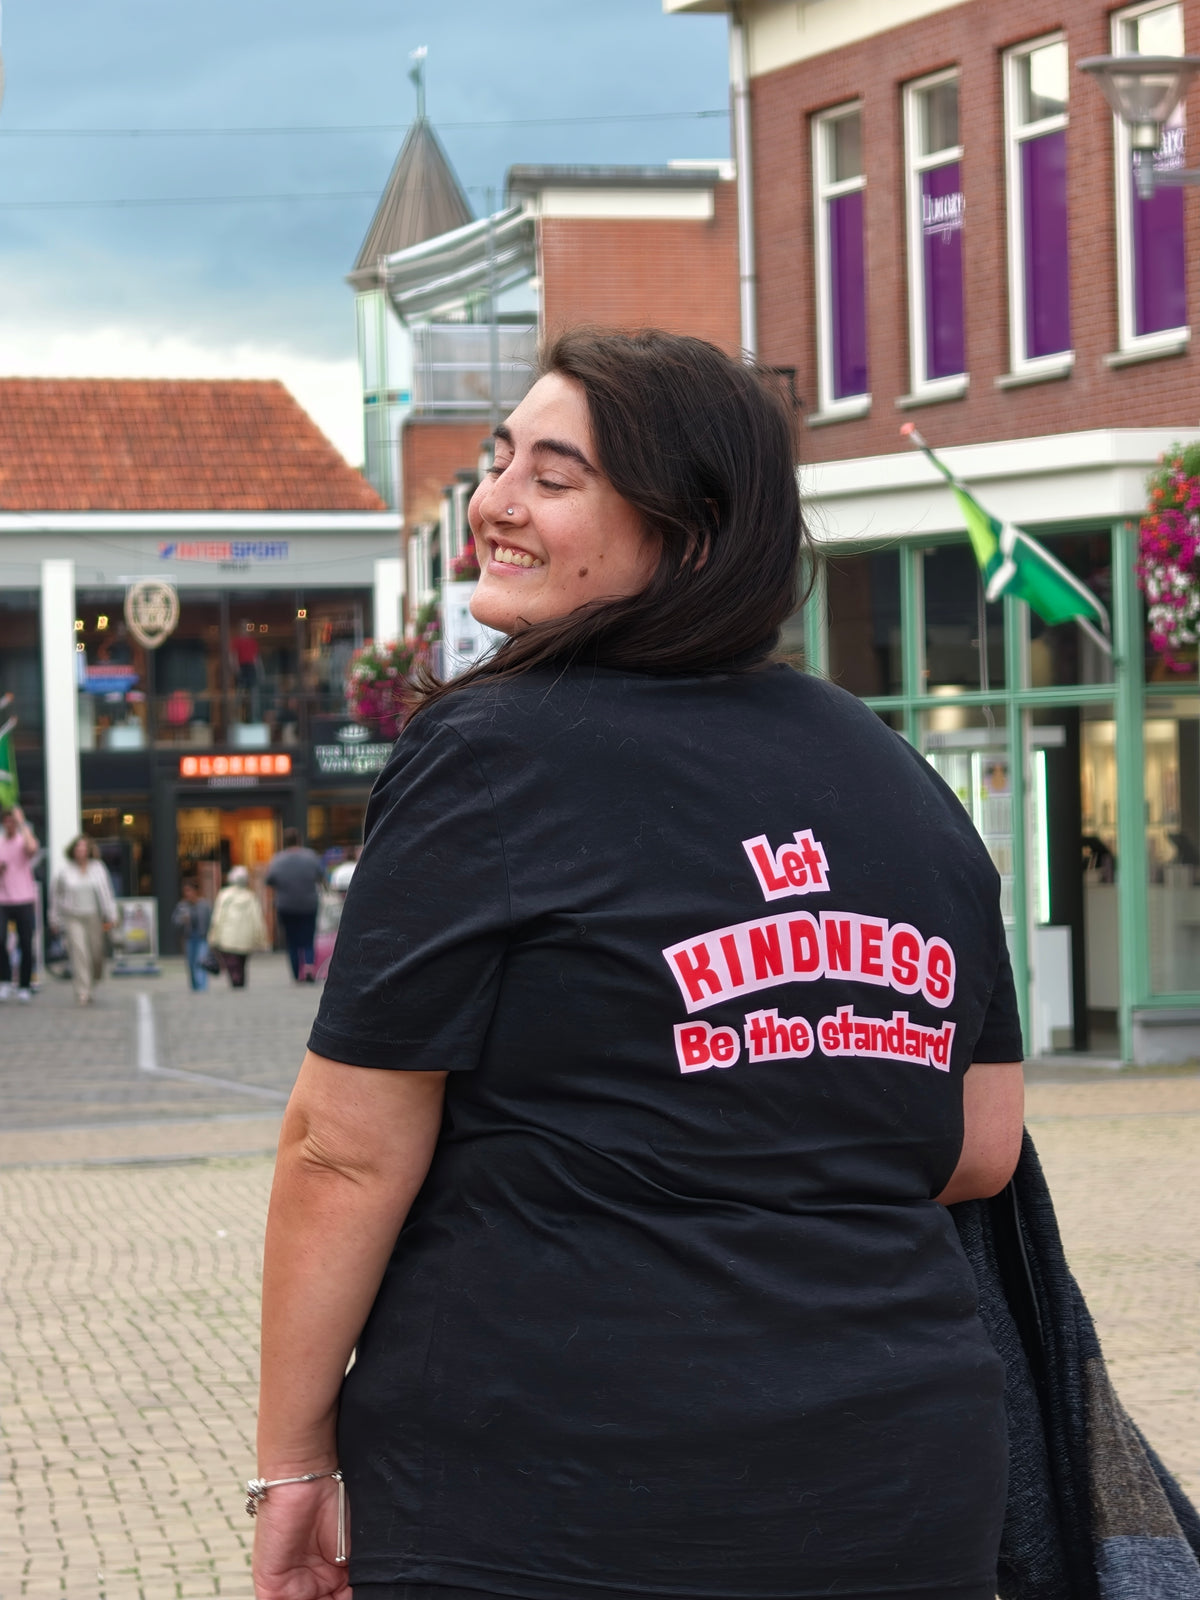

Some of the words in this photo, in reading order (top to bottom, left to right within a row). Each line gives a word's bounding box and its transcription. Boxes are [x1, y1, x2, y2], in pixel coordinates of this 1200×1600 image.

[751, 837, 823, 893] Let
[672, 918, 952, 1004] KINDNESS
[679, 1026, 735, 1067] Be
[748, 1015, 810, 1057] the
[821, 1011, 952, 1065] standard
